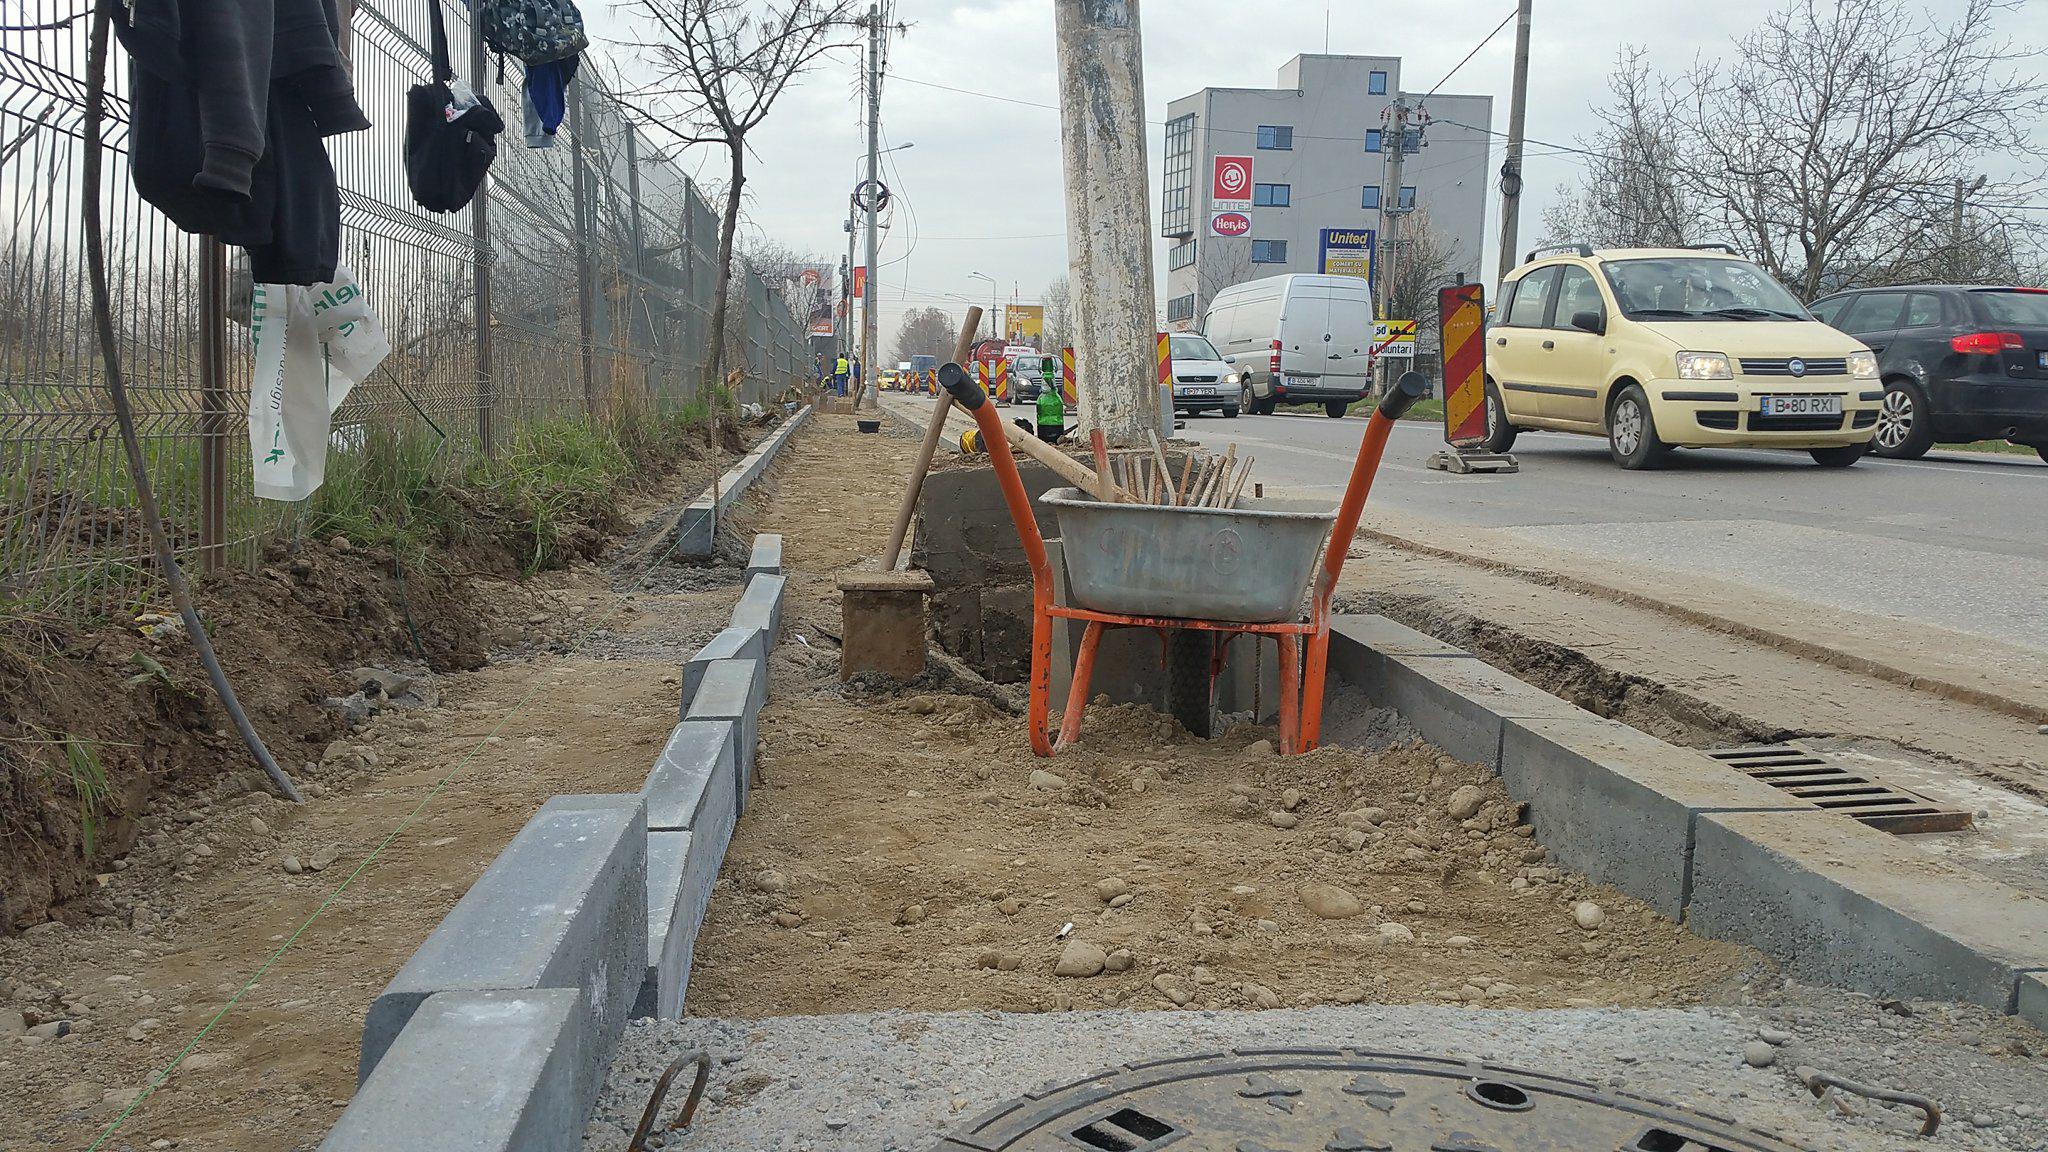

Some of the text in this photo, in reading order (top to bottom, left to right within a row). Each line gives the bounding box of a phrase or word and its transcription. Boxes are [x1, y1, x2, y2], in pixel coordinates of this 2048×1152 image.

[1216, 218, 1247, 231] Hervis
[1330, 231, 1368, 244] United
[1376, 326, 1386, 335] 50
[1375, 343, 1412, 354] Voluntari
[1775, 399, 1833, 413] B 80 RXI
